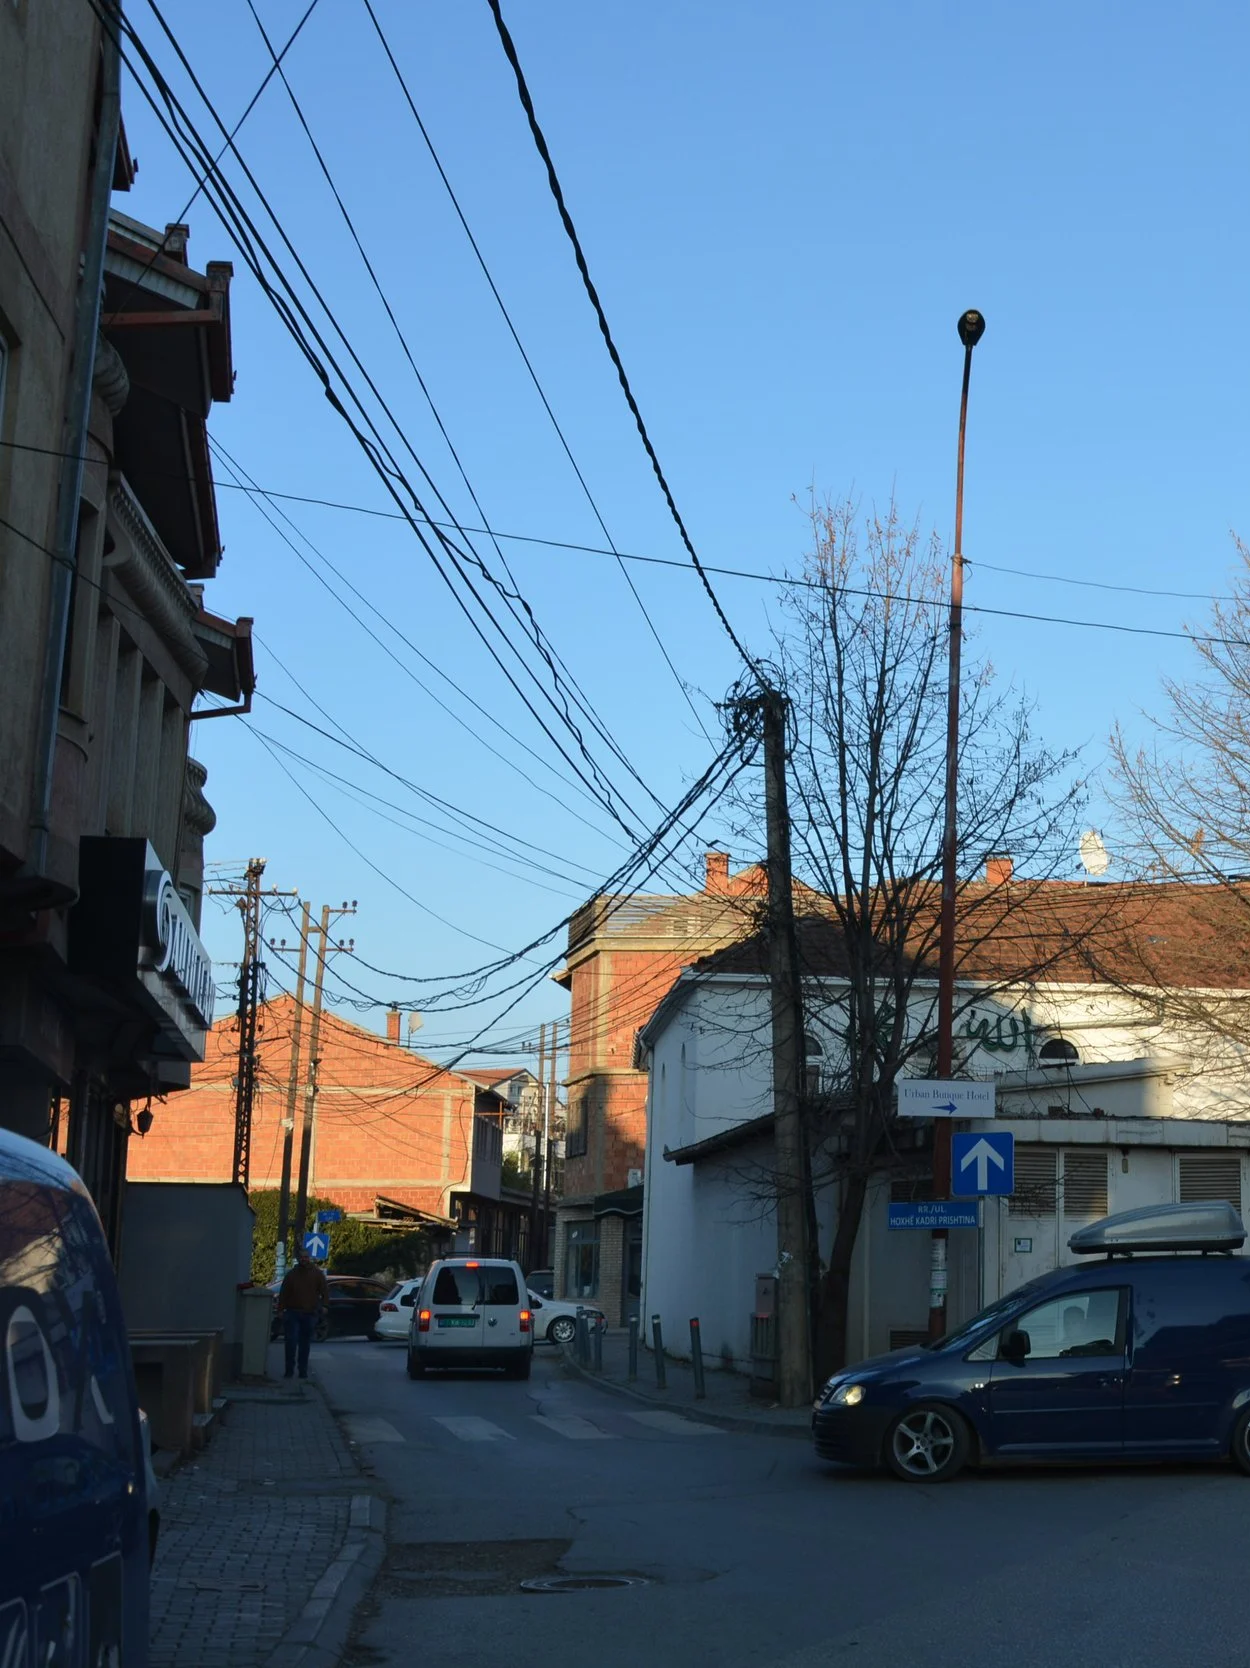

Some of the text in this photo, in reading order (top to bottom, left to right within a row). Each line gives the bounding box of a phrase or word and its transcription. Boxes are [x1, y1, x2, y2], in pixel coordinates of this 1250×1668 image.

[904, 1089, 930, 1099] Urban
[966, 1091, 990, 1101] Hotel
[917, 1204, 947, 1214] RR./UL.
[890, 1215, 976, 1226] HOXHË KADRI PRISHTINA
